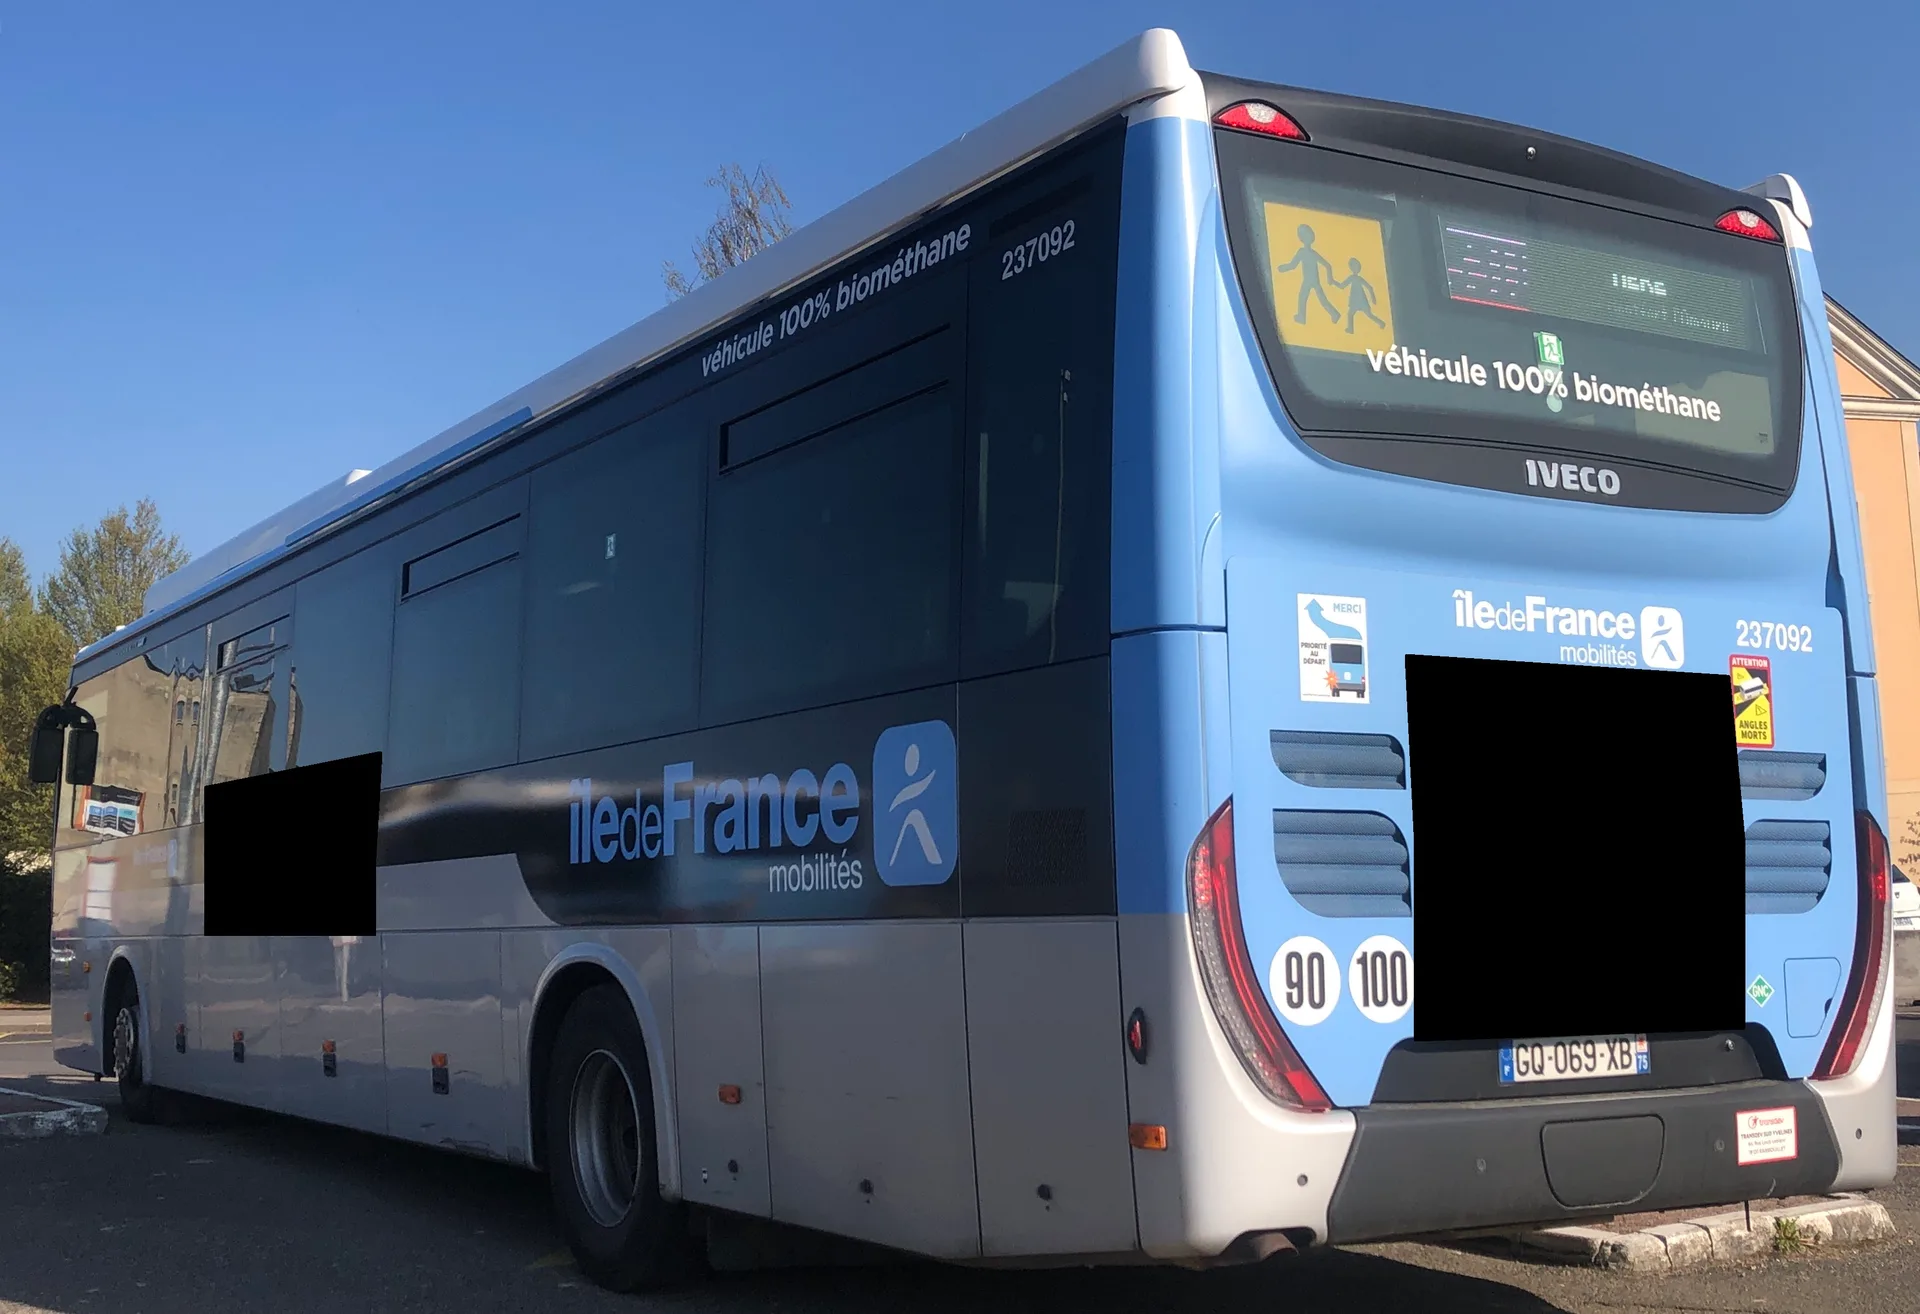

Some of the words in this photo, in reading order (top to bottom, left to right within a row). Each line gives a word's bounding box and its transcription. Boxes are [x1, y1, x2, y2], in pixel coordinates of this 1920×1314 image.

[1001, 219, 1076, 281] 237092
[702, 321, 775, 377] véhicule
[779, 288, 831, 341] 100%
[836, 223, 972, 312] biométhane
[1365, 344, 1488, 387] véhicule
[1492, 361, 1569, 399] 100%
[1573, 372, 1722, 422] biométhane
[1525, 458, 1621, 495] IVECO
[1333, 603, 1362, 614] MERCI
[1301, 642, 1328, 650] PRIORITÉ
[1736, 619, 1813, 653] 237092
[1560, 642, 1637, 668] mobilités
[1732, 657, 1768, 668] ATTENTION
[1739, 720, 1768, 730] ANGLES
[1741, 730, 1767, 740] MORTS
[769, 849, 863, 893] mobilités
[1285, 951, 1326, 1010] 90
[1356, 950, 1408, 1008] 100
[1752, 985, 1770, 998] GNC
[1515, 1038, 1633, 1077] GQ-069-XB
[1637, 1055, 1649, 1071] 75
